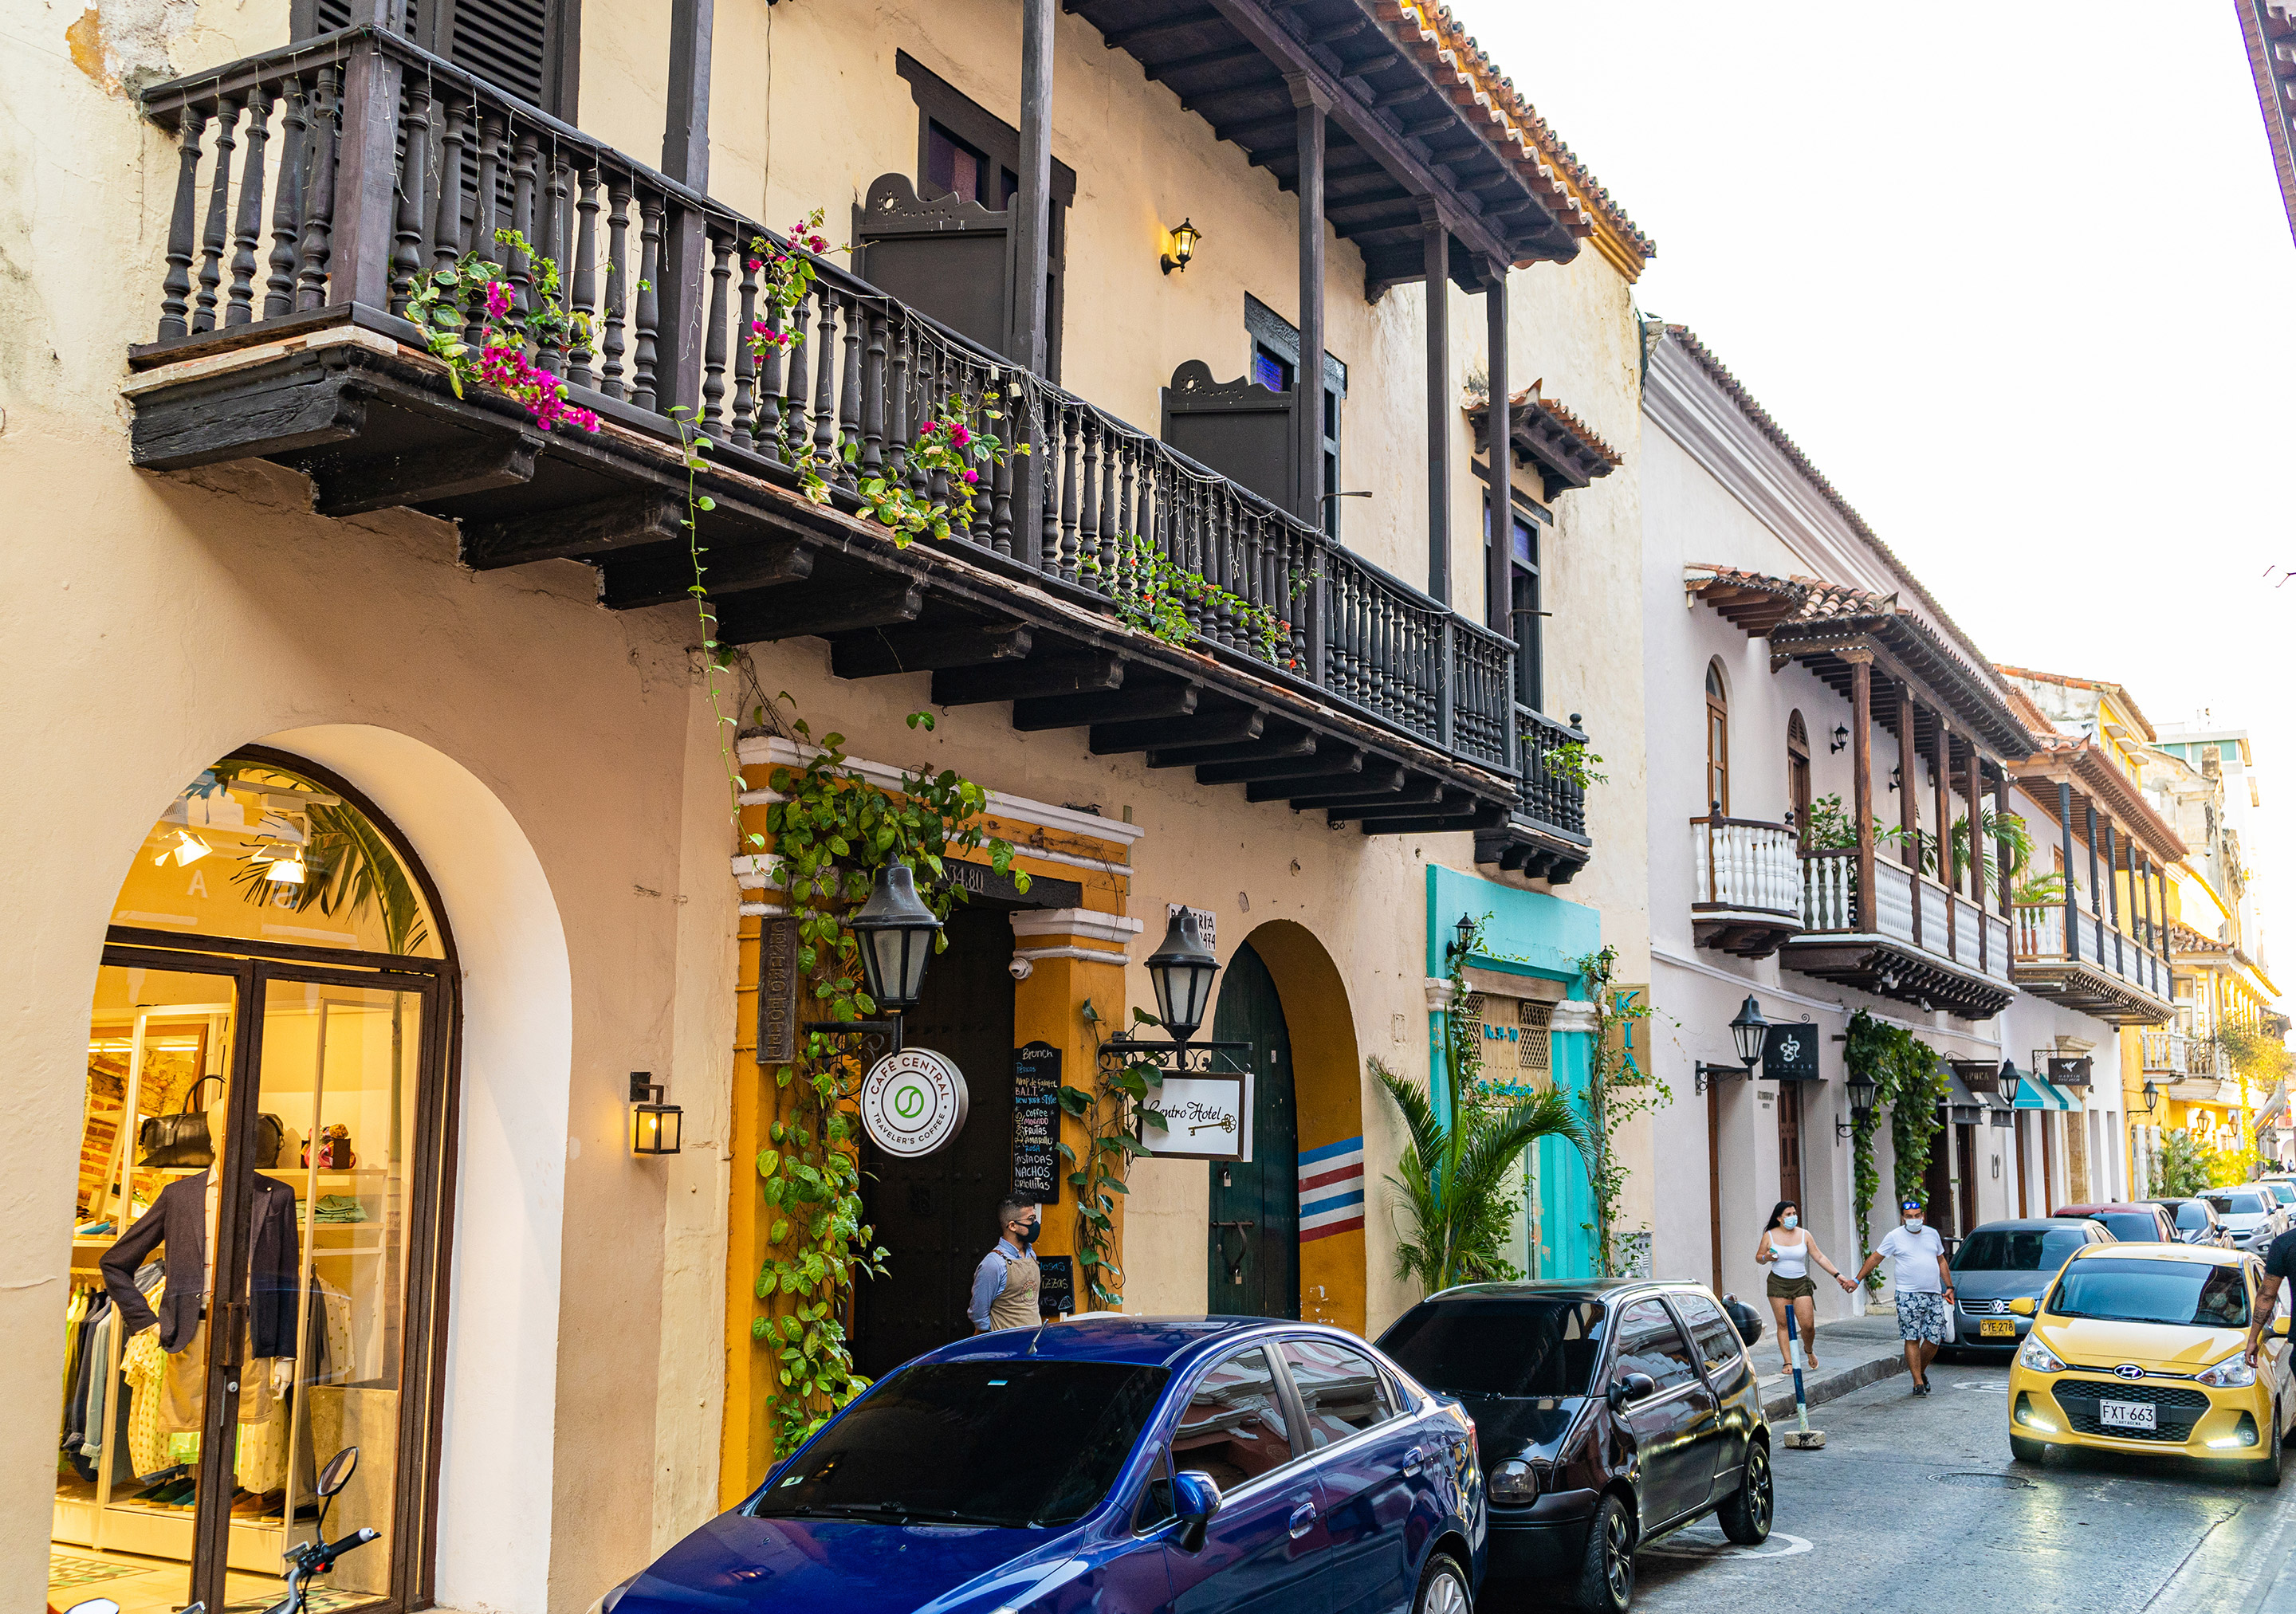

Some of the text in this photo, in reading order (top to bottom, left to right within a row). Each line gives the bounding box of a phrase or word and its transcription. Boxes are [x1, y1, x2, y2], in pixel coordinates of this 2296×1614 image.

[1614, 991, 1645, 1078] KIA
[871, 1057, 949, 1101] CAFÉ CENTRAL
[1187, 1102, 1222, 1122] Hotel
[873, 1113, 946, 1145] TRAVELER'S COFFEE
[1015, 1165, 1051, 1178] NACHOS
